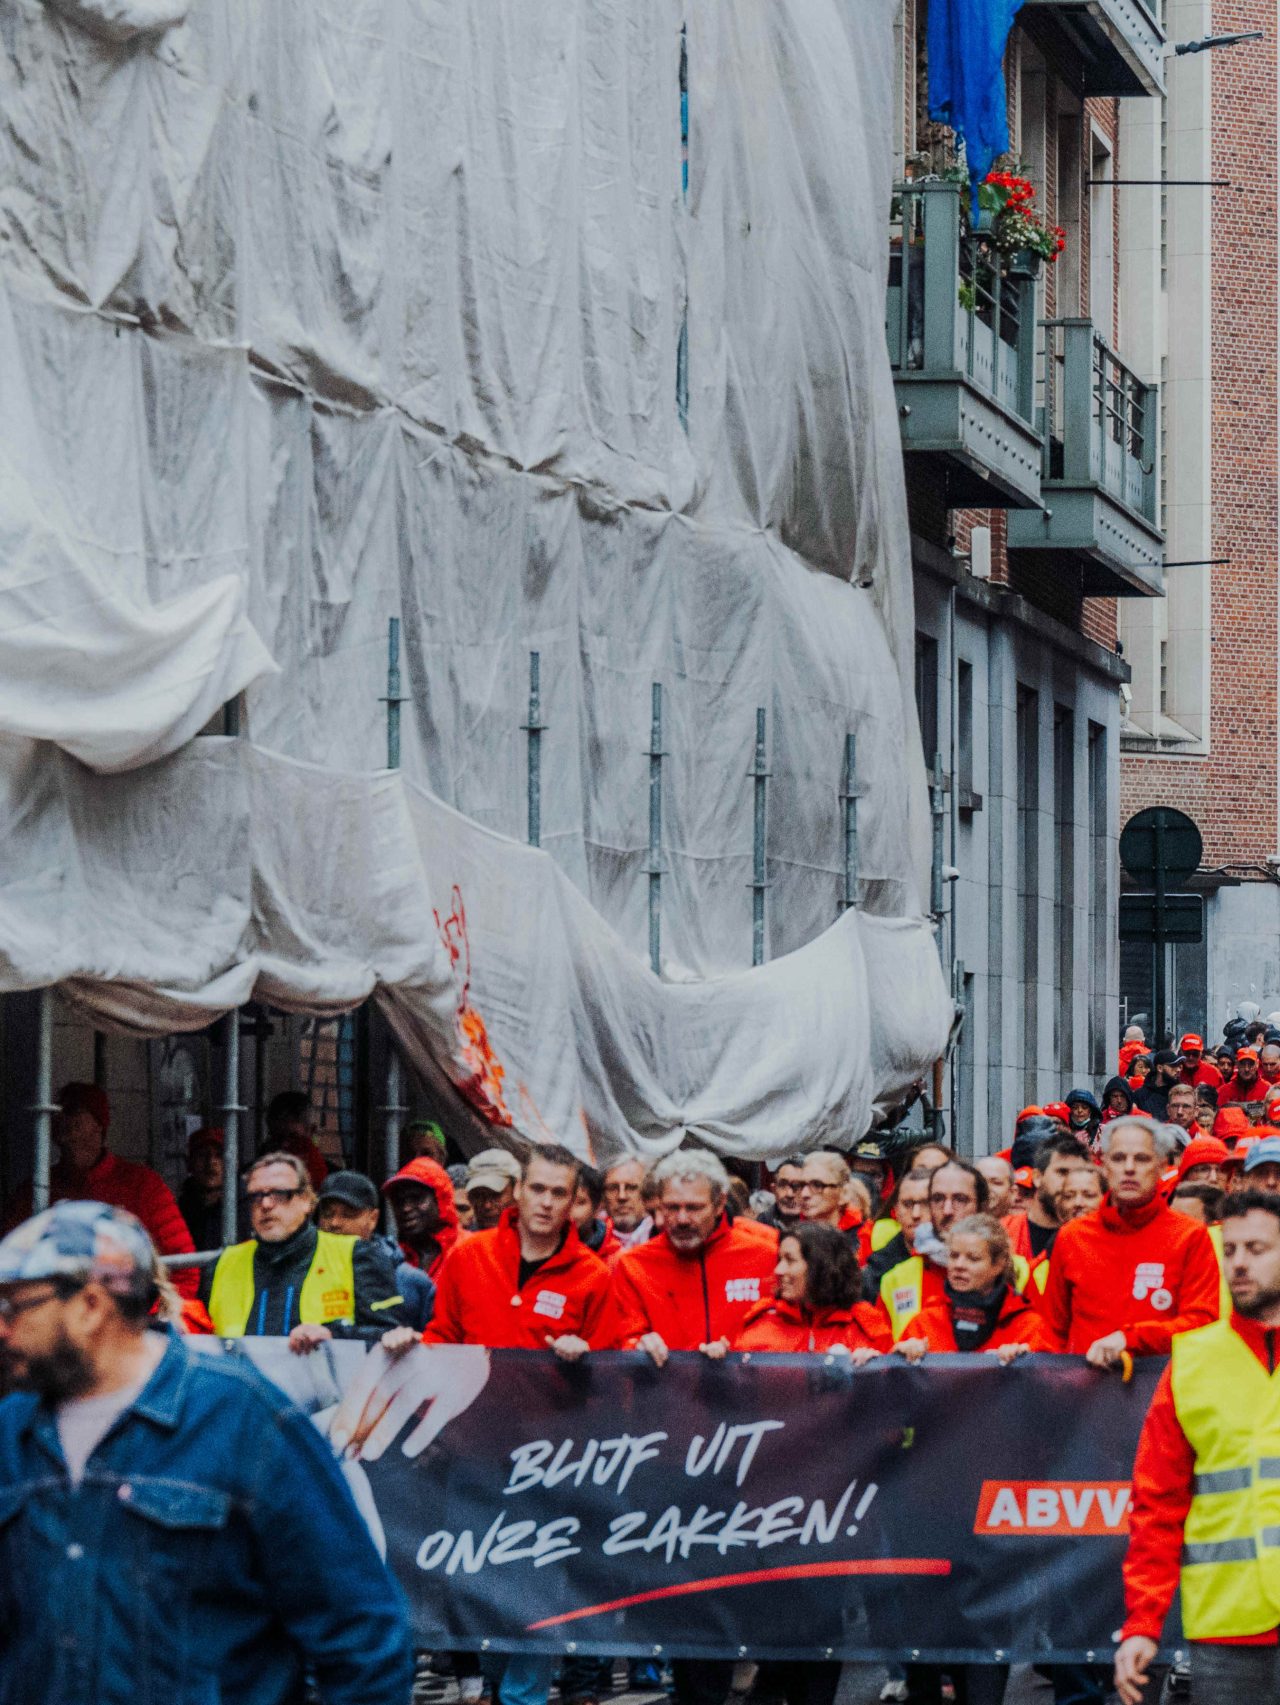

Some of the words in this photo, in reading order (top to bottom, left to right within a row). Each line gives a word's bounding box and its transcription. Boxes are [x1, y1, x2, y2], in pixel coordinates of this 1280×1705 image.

[503, 1432, 668, 1495] BLIJF
[685, 1420, 785, 1486] UIT
[416, 1510, 583, 1575] ONZE
[602, 1480, 880, 1564] ZAKKEN!
[986, 1488, 1131, 1528] ABVV
